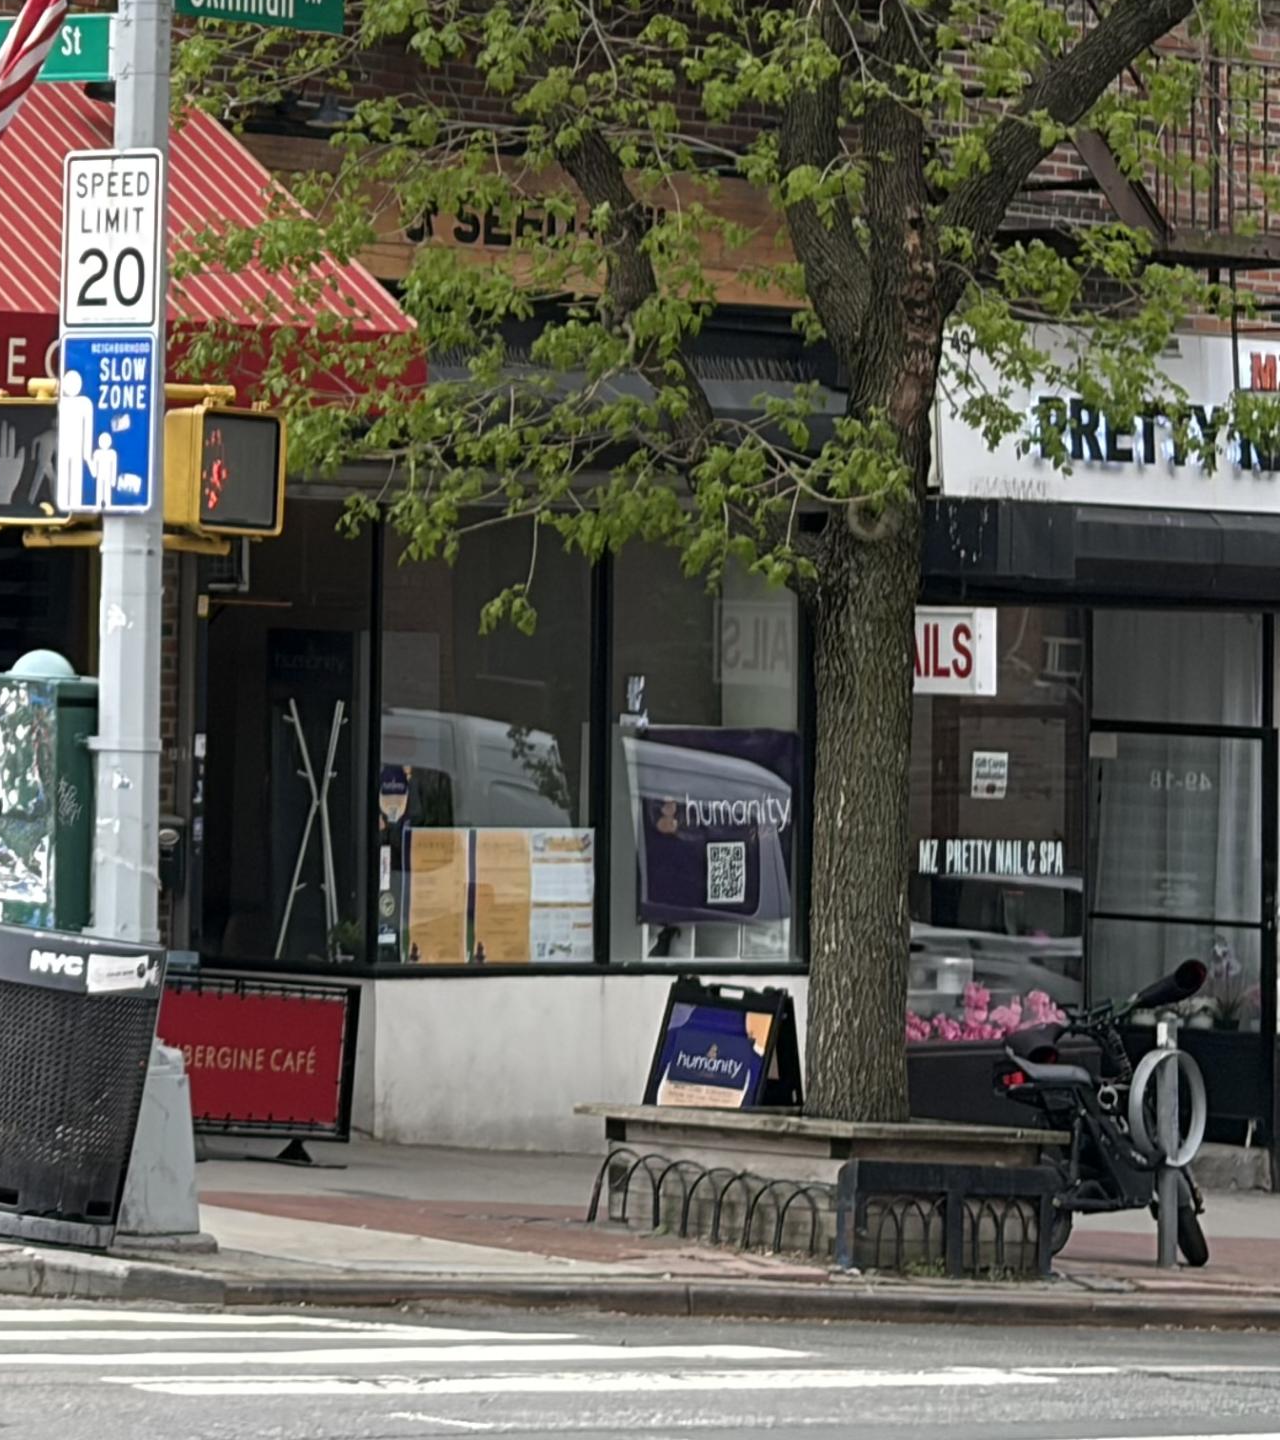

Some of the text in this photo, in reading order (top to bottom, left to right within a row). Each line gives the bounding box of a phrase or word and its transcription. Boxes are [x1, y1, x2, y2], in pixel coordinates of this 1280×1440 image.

[61, 25, 82, 57] St
[76, 171, 149, 198] SPEED
[81, 207, 144, 234] LIMIT
[77, 247, 145, 307] 20
[99, 357, 147, 382] SLOW
[98, 384, 147, 409] ZONE
[685, 792, 790, 833] humanity
[919, 839, 939, 874] MZ
[946, 839, 992, 875] PRETTY
[996, 840, 1024, 875] NAIL
[1040, 840, 1064, 875] SPA
[30, 950, 84, 975] NYC
[183, 1044, 317, 1074] BERGINE CAFÉ
[676, 1050, 743, 1079] humanity
